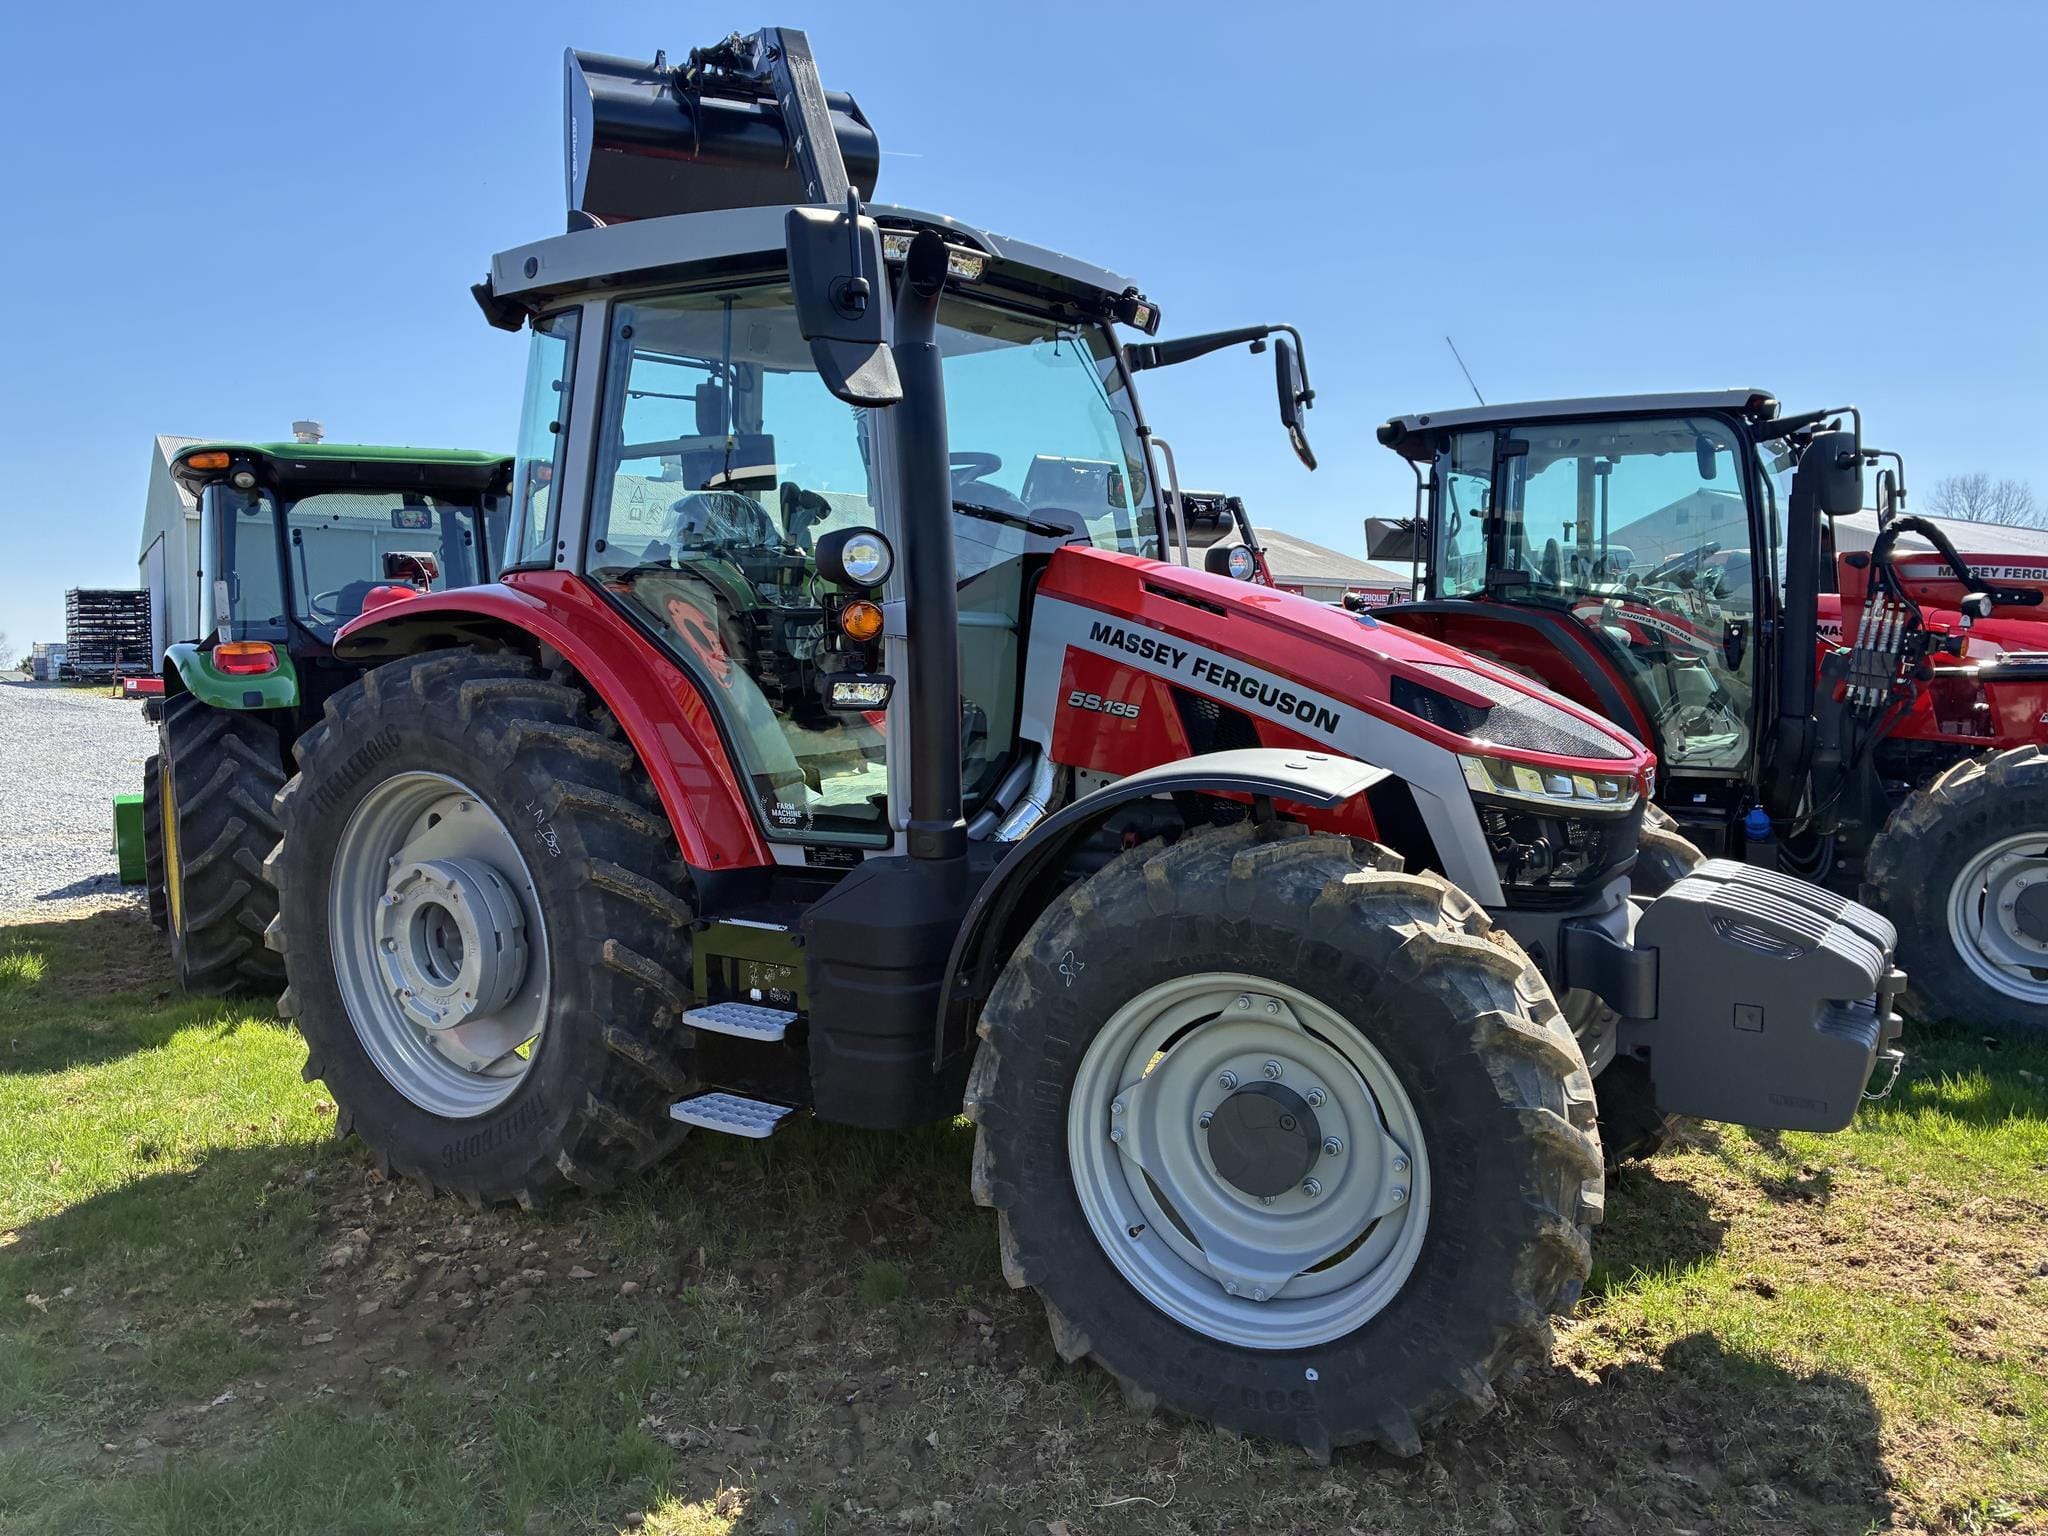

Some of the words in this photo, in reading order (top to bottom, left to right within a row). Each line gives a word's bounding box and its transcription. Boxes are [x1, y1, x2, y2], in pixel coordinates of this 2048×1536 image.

[1089, 621, 1188, 669] MASSEY
[1191, 657, 1341, 734] FERGUSON
[1067, 690, 1140, 719] 5S.135
[776, 802, 795, 811] FARM
[771, 809, 802, 818] MACHINE
[779, 817, 797, 825] 2023
